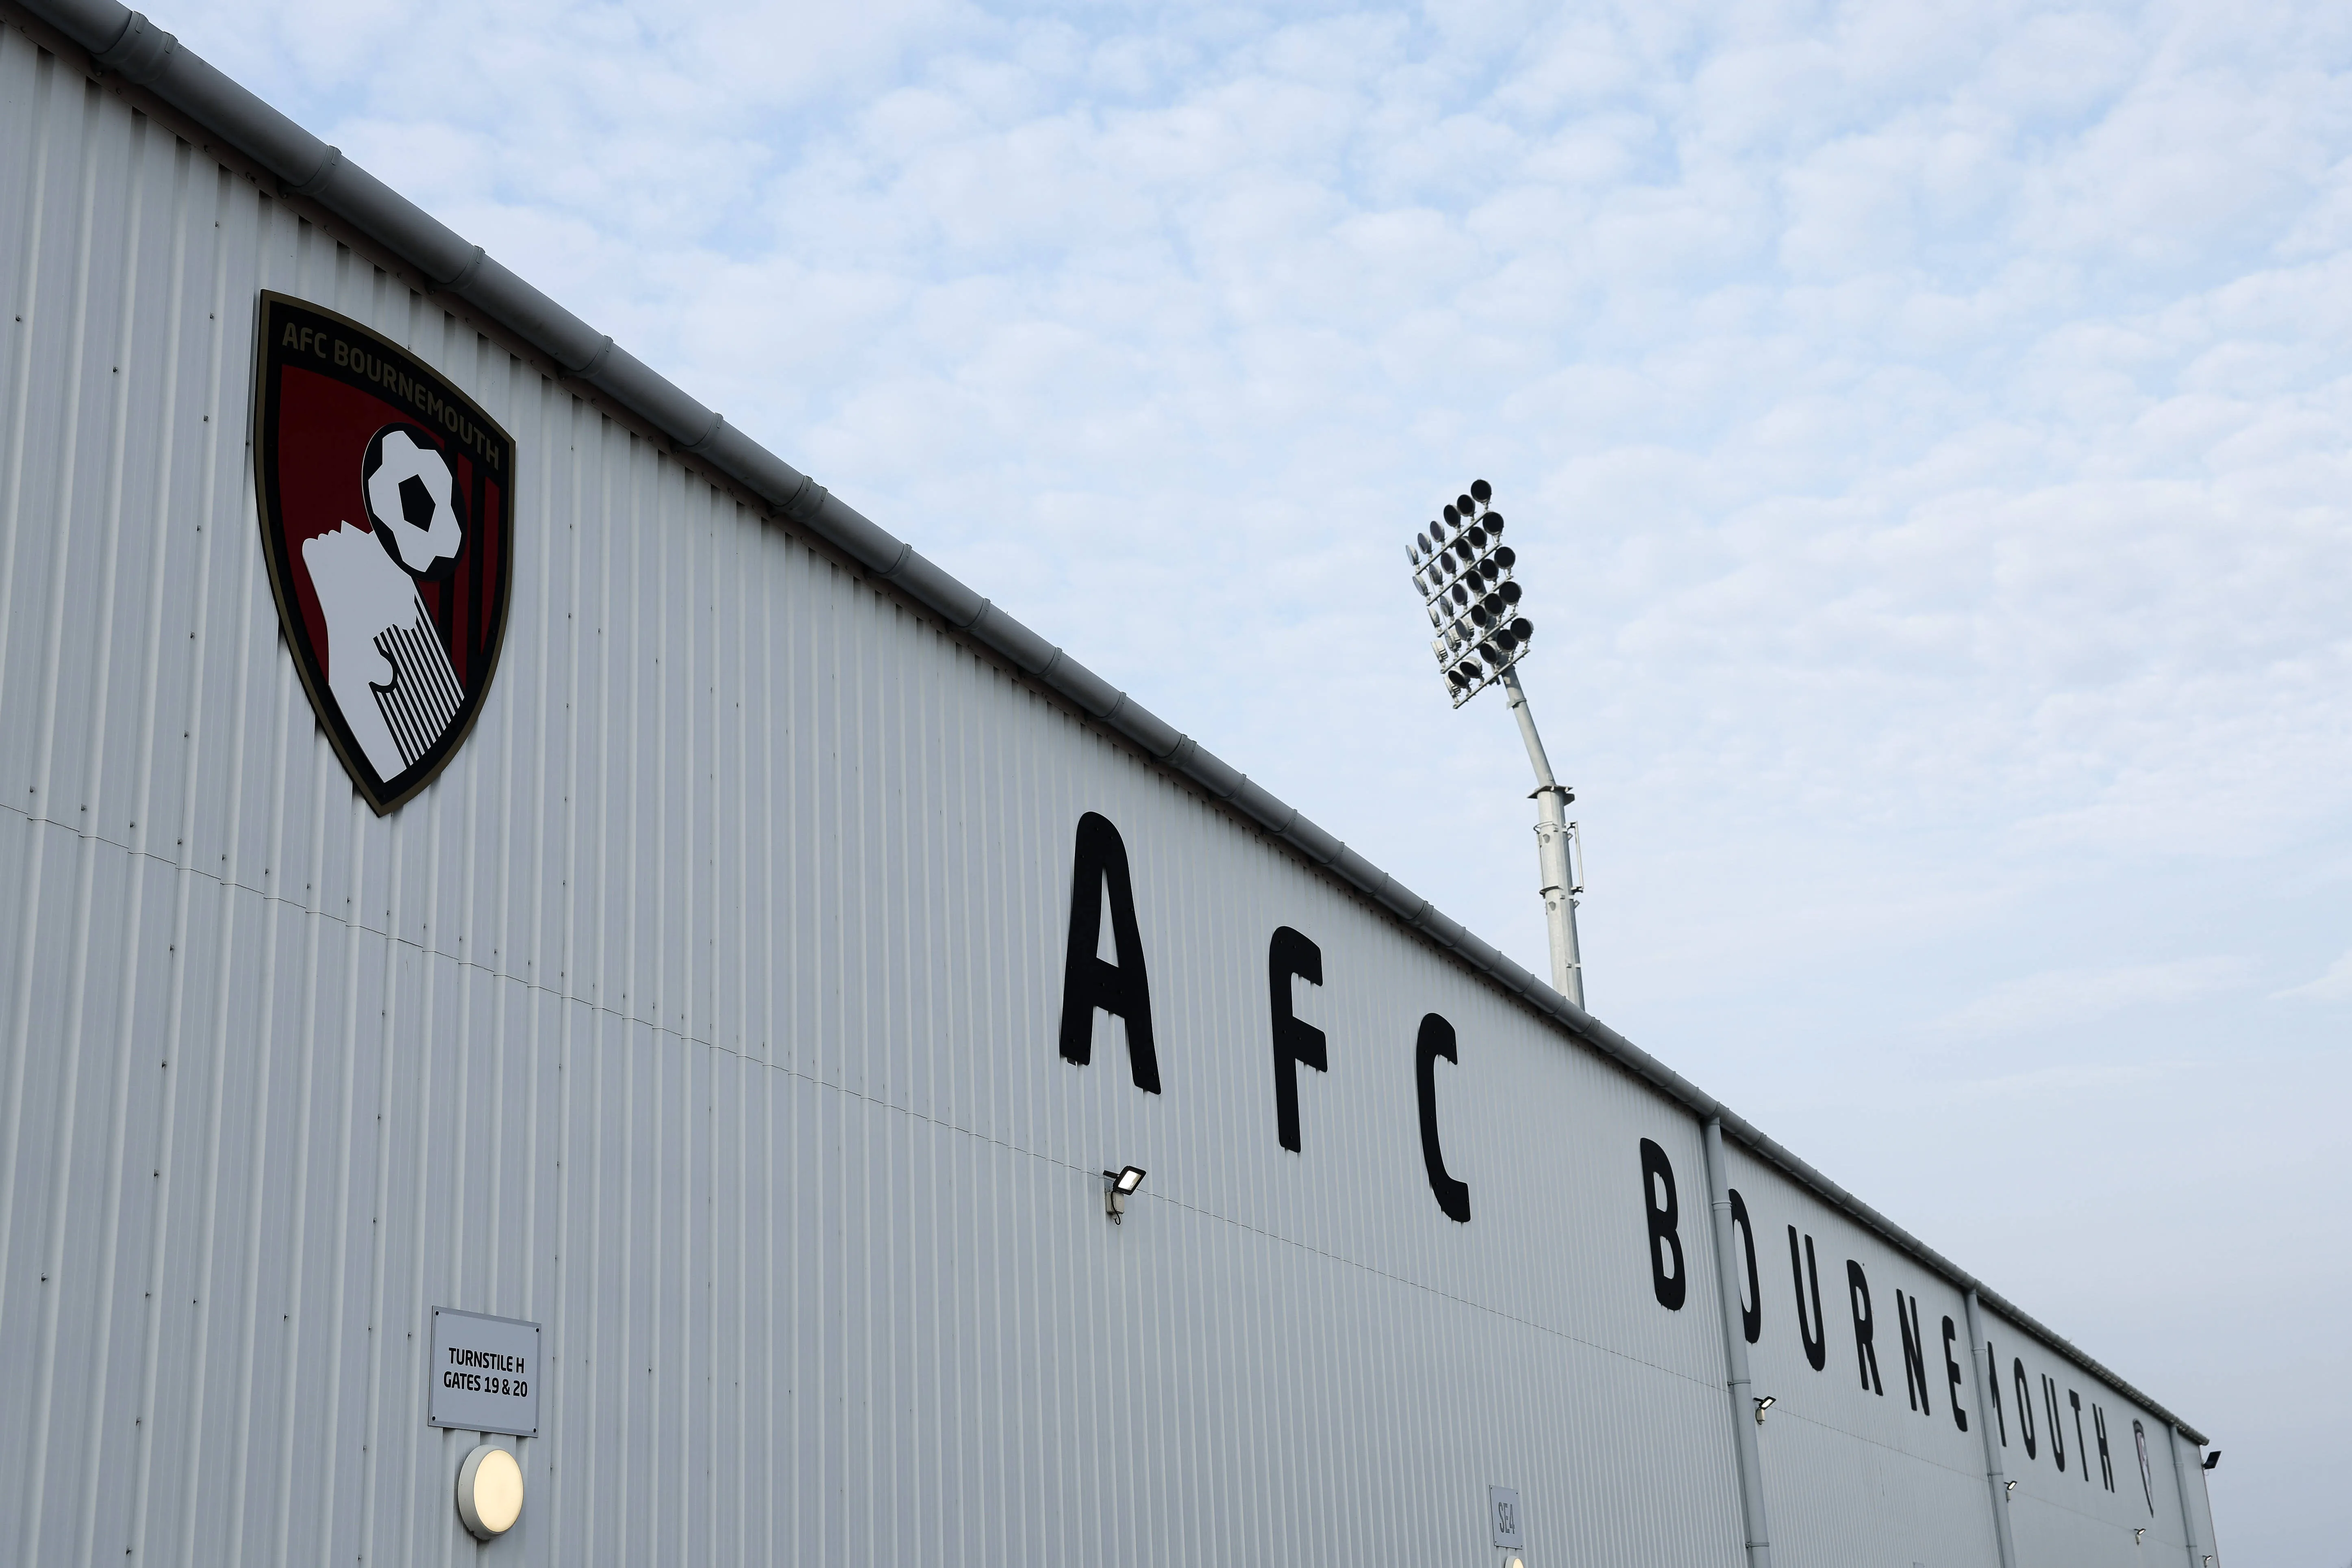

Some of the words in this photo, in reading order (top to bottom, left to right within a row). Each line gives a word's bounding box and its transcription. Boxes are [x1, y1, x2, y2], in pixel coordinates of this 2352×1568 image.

[282, 322, 327, 358] AFC
[334, 339, 499, 471] BOURNEMOUTH
[1059, 811, 1471, 1222] AFC
[448, 1347, 513, 1372] TURNSTILE
[516, 1357, 524, 1374] H
[443, 1371, 481, 1392] GATES
[484, 1377, 499, 1394] 19
[502, 1379, 511, 1396] &
[513, 1380, 528, 1397] 20
[1498, 1502, 1515, 1534] SE4
